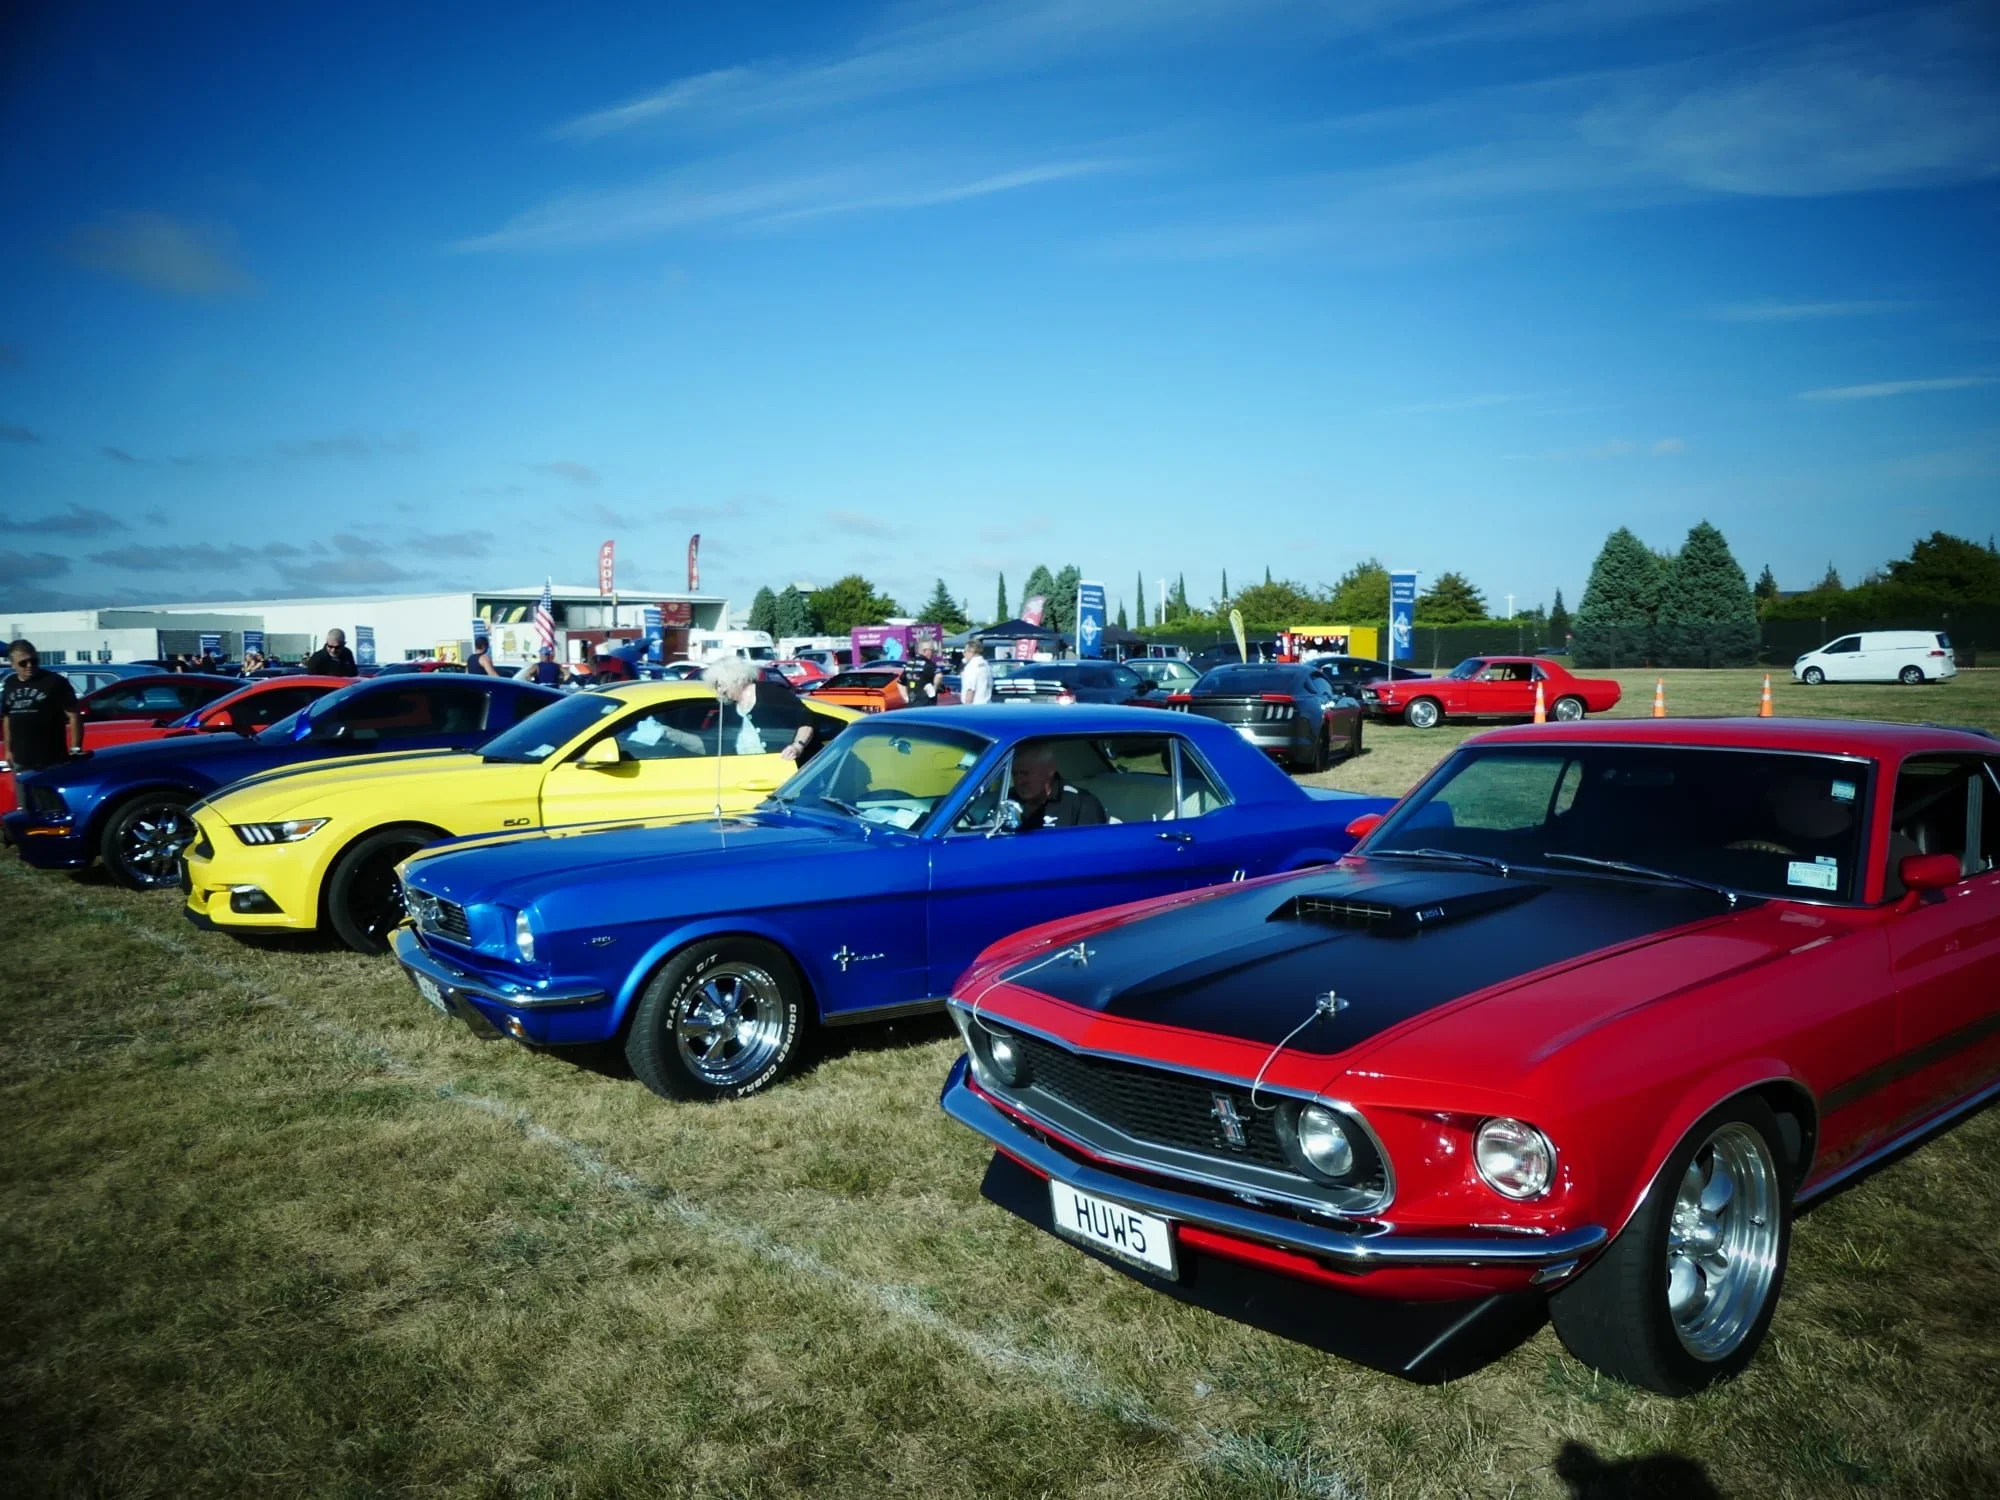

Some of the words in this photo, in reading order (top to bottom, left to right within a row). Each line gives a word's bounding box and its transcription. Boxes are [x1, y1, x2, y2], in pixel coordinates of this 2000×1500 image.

[602, 546, 612, 590] FOOD
[666, 974, 695, 1030] RADIAL
[776, 1003, 797, 1063] COOPER
[736, 1063, 777, 1097] COBRA
[1074, 1194, 1147, 1254] HUW5
